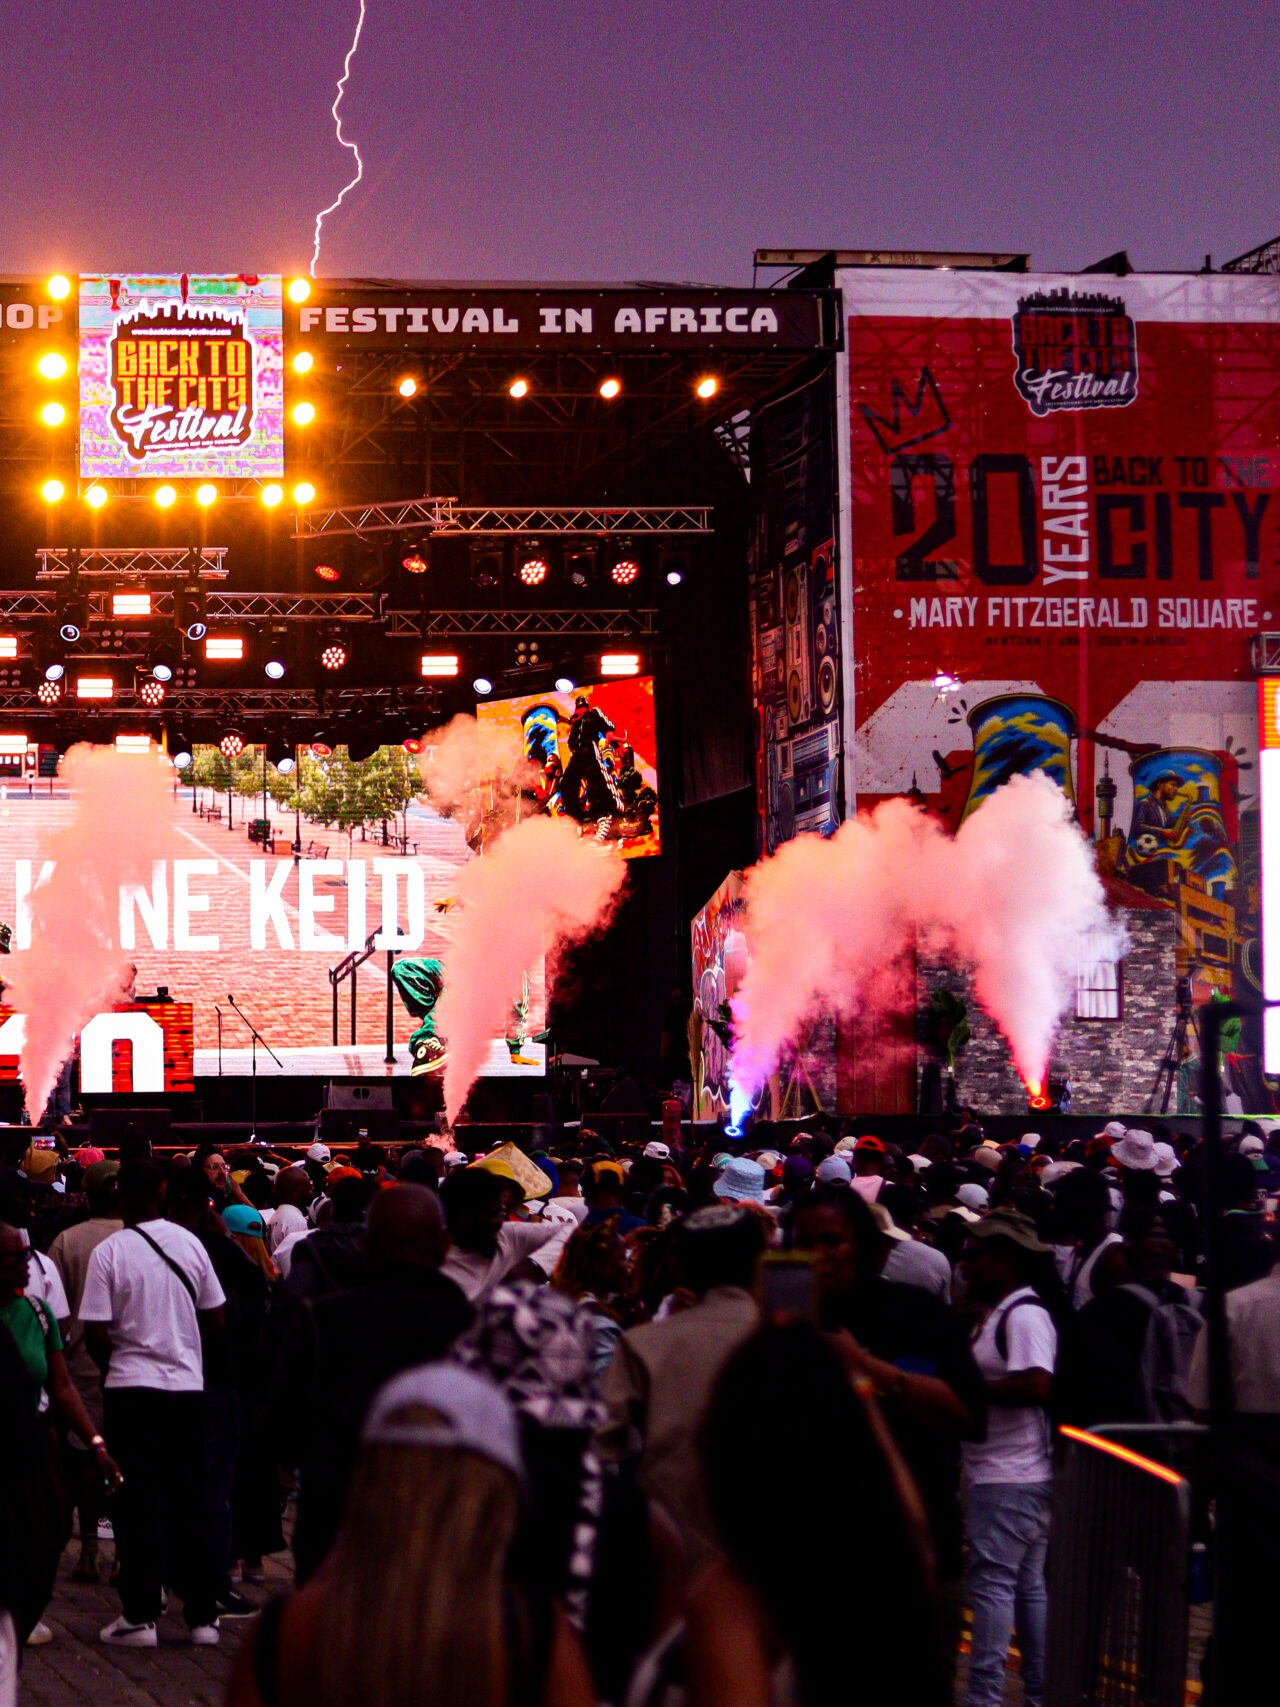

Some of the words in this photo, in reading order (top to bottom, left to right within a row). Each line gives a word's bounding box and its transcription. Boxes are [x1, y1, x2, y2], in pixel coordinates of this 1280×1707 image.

[300, 306, 519, 334] FESTIVAL
[539, 307, 593, 334] IN
[614, 307, 779, 334] AFRICA
[118, 340, 200, 376] BACK
[205, 340, 247, 376] TO
[117, 376, 174, 411] THE
[178, 376, 247, 411] CITY
[1022, 368, 1131, 406] Festival
[116, 404, 248, 450] Festival
[1093, 455, 1163, 487] BACK
[1174, 456, 1210, 488] TO
[1220, 457, 1272, 489] THE
[889, 453, 1038, 586] 20
[1041, 455, 1090, 586] YEARS
[1094, 491, 1272, 580] CITY
[910, 596, 979, 629] MARY
[987, 597, 1149, 629] FITZGERALD
[1158, 598, 1259, 630] SQUARE
[15, 858, 221, 952] KNE
[249, 857, 426, 952] KEID
